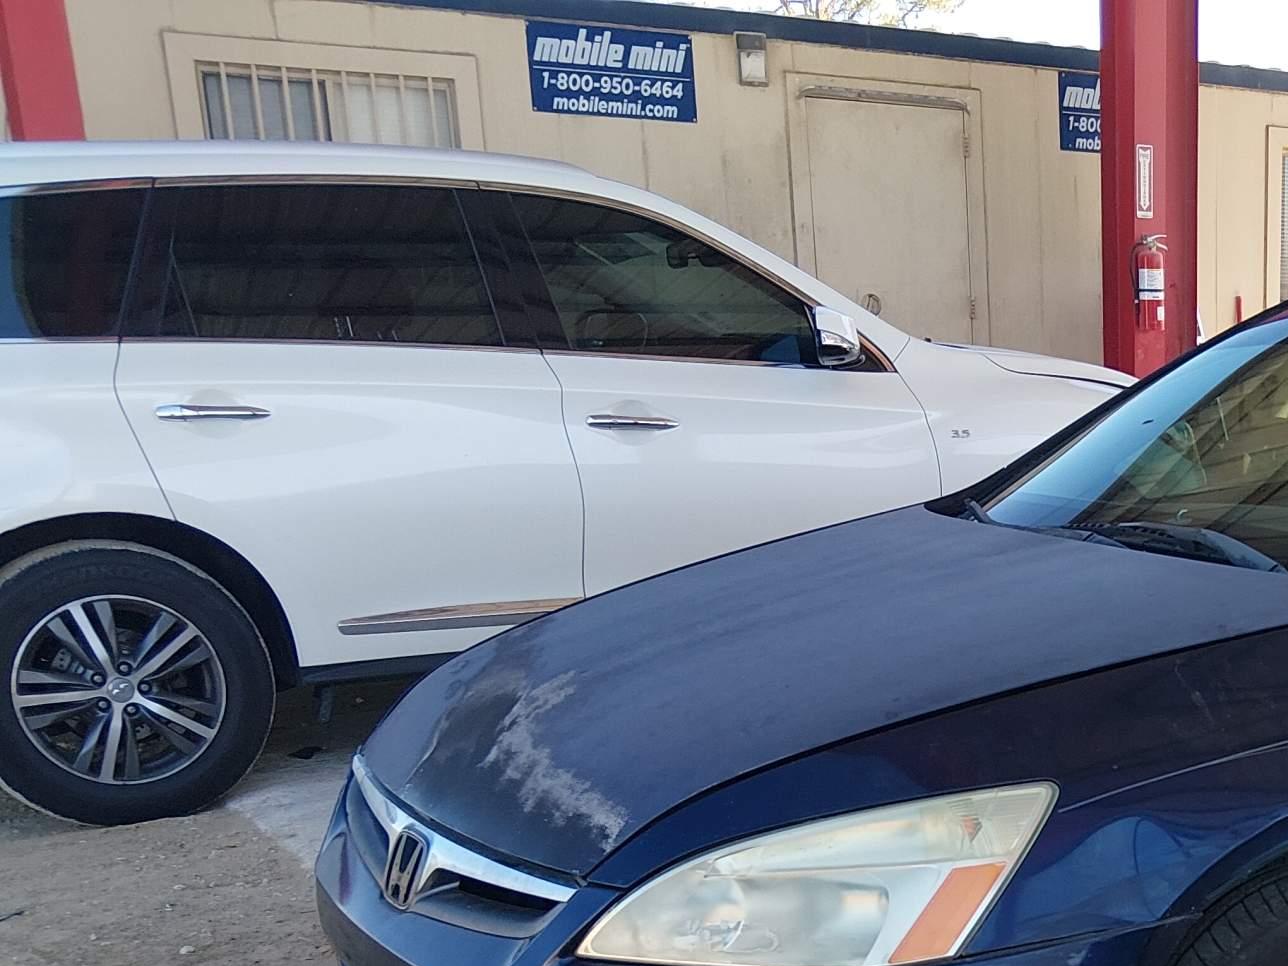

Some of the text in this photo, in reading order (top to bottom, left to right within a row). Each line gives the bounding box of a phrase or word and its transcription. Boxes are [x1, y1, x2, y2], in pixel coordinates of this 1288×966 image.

[533, 28, 687, 73] mobile mini
[542, 71, 684, 99] 1-800-950-6464
[553, 95, 678, 118] mobilemini.com
